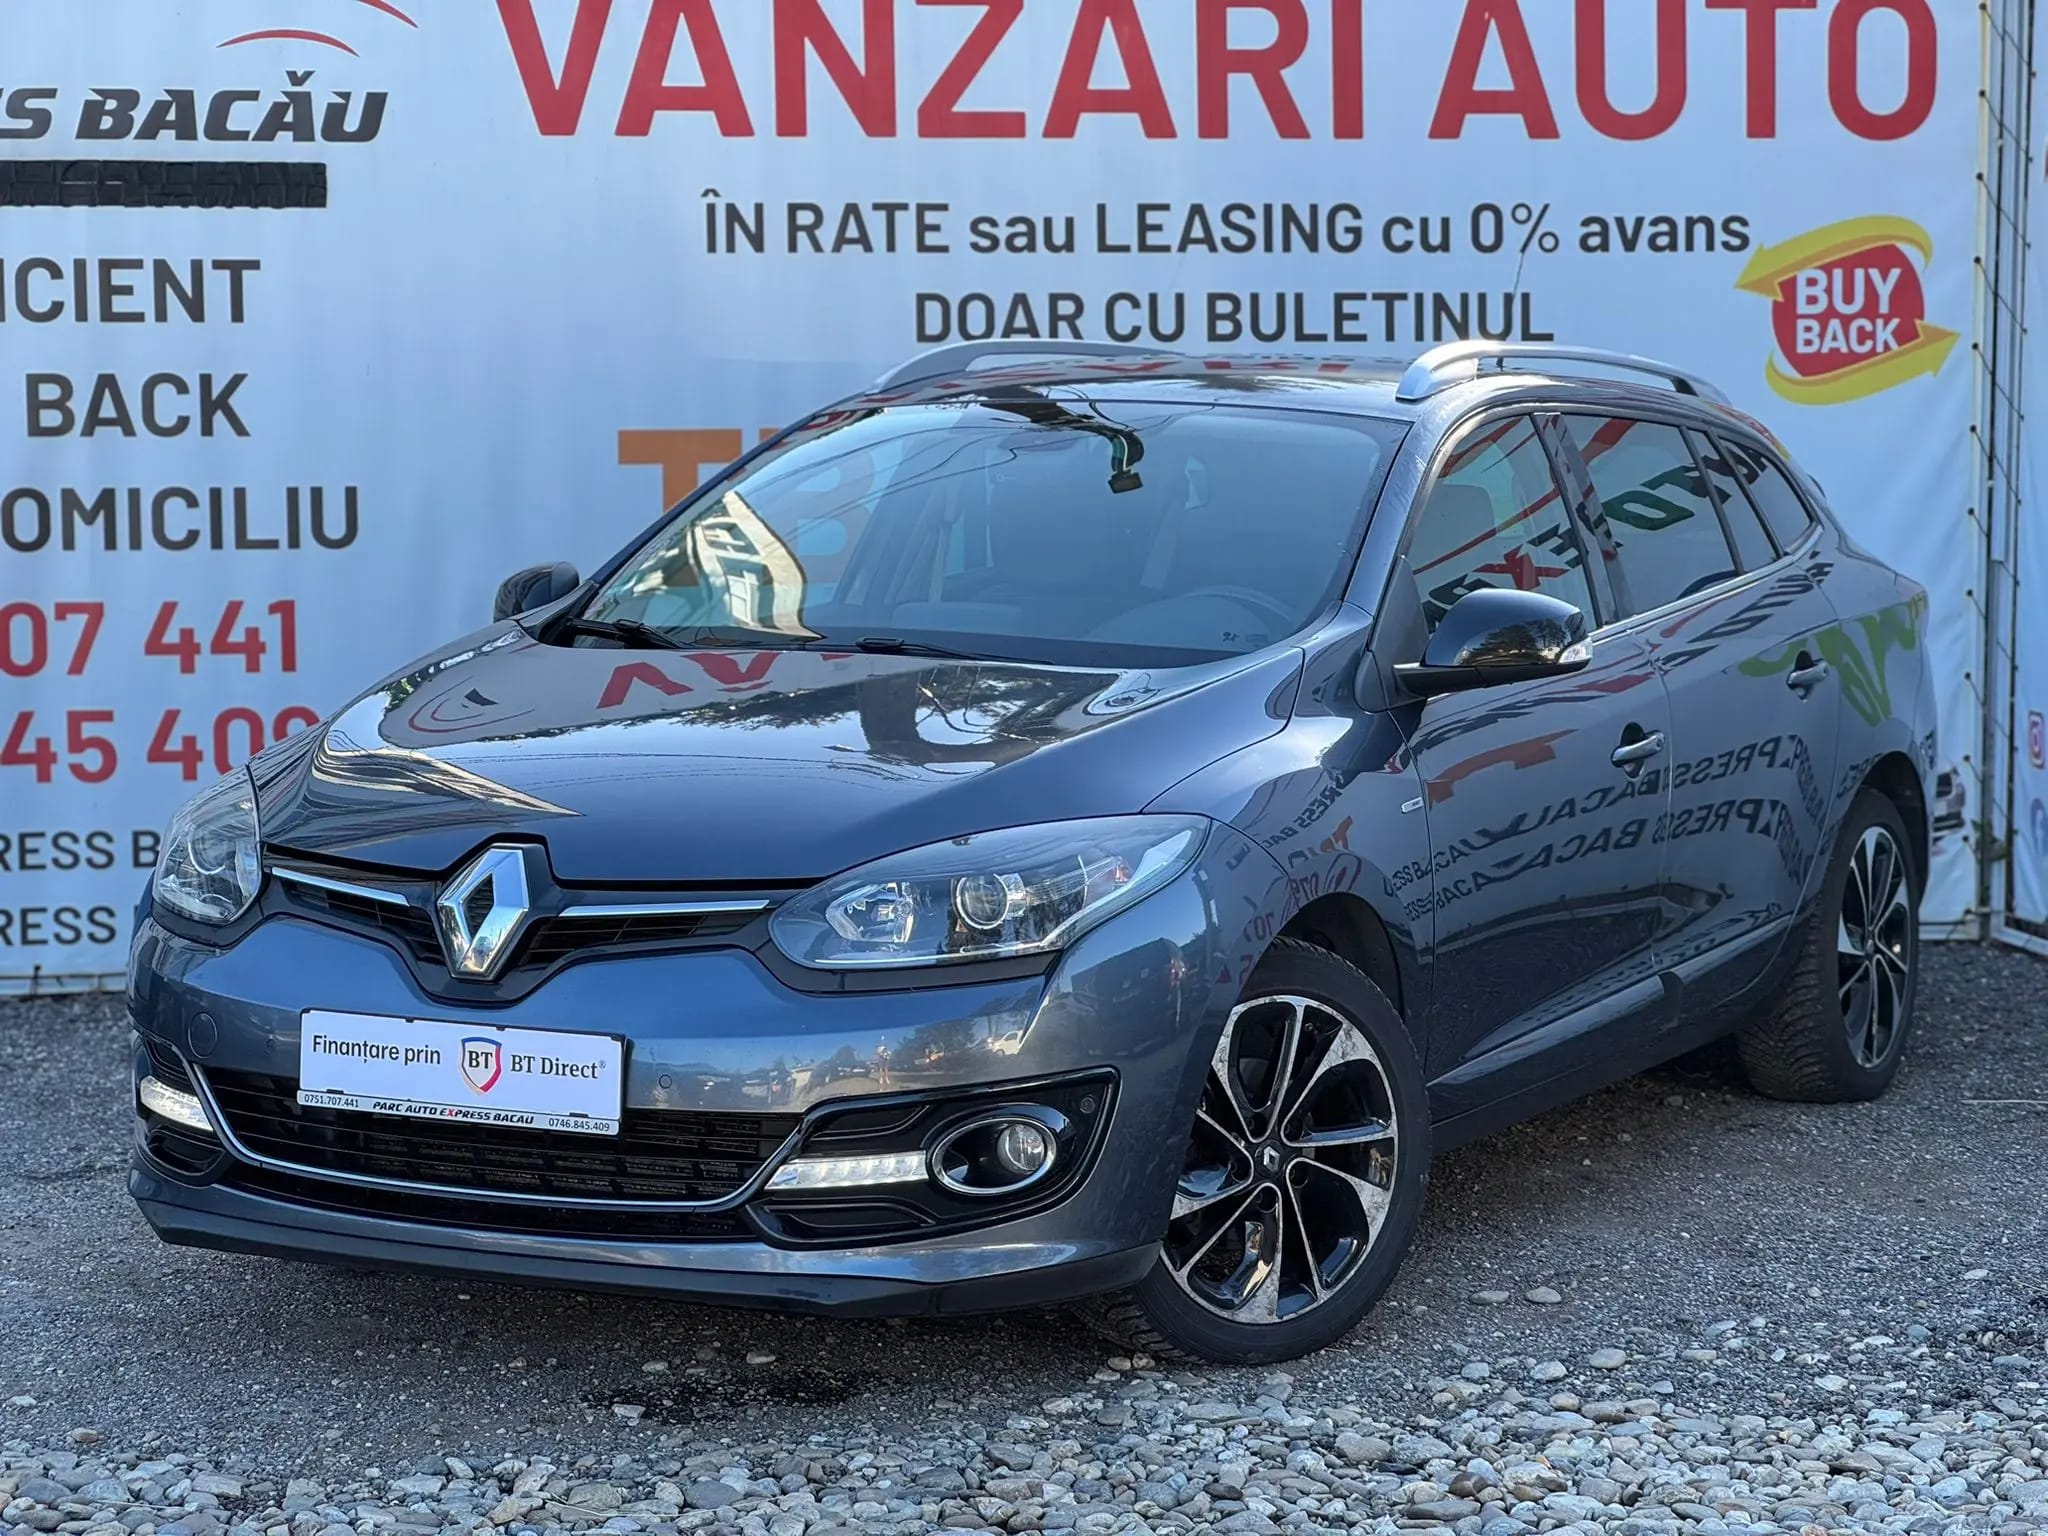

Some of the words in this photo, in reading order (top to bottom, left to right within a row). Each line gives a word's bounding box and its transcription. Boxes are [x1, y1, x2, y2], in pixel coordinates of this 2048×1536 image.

[1428, 0, 1938, 141] AUTO
[0, 87, 58, 142] S
[75, 70, 389, 143] BACĂU
[701, 188, 765, 255] ÎN
[788, 202, 950, 255] RATE
[970, 213, 1075, 256] sau
[1097, 202, 1363, 256] LEASING
[1382, 213, 1451, 255] cu
[1471, 202, 1560, 256] 0%
[1579, 212, 1750, 256] avans
[1796, 268, 1901, 315] BUY
[916, 291, 1085, 344] DOAR
[1106, 291, 1185, 344] CU
[1207, 291, 1555, 344] BULETINUL
[1796, 318, 1901, 354] BACK
[26, 372, 251, 438] BACK
[0, 600, 105, 678] 07
[144, 599, 297, 675] 441
[0, 709, 118, 784] 45
[312, 1034, 400, 1064] Finanțare
[404, 1044, 441, 1066] prin
[467, 1050, 493, 1069] BT
[511, 1054, 535, 1073] BT
[304, 1094, 359, 1108] 0751.707.441
[373, 1101, 402, 1113] PARC
[405, 1105, 437, 1116] AUTO
[439, 1107, 490, 1120] EXPRESS
[493, 1113, 534, 1125] BACAU
[549, 1118, 610, 1132] 0746.845.409
